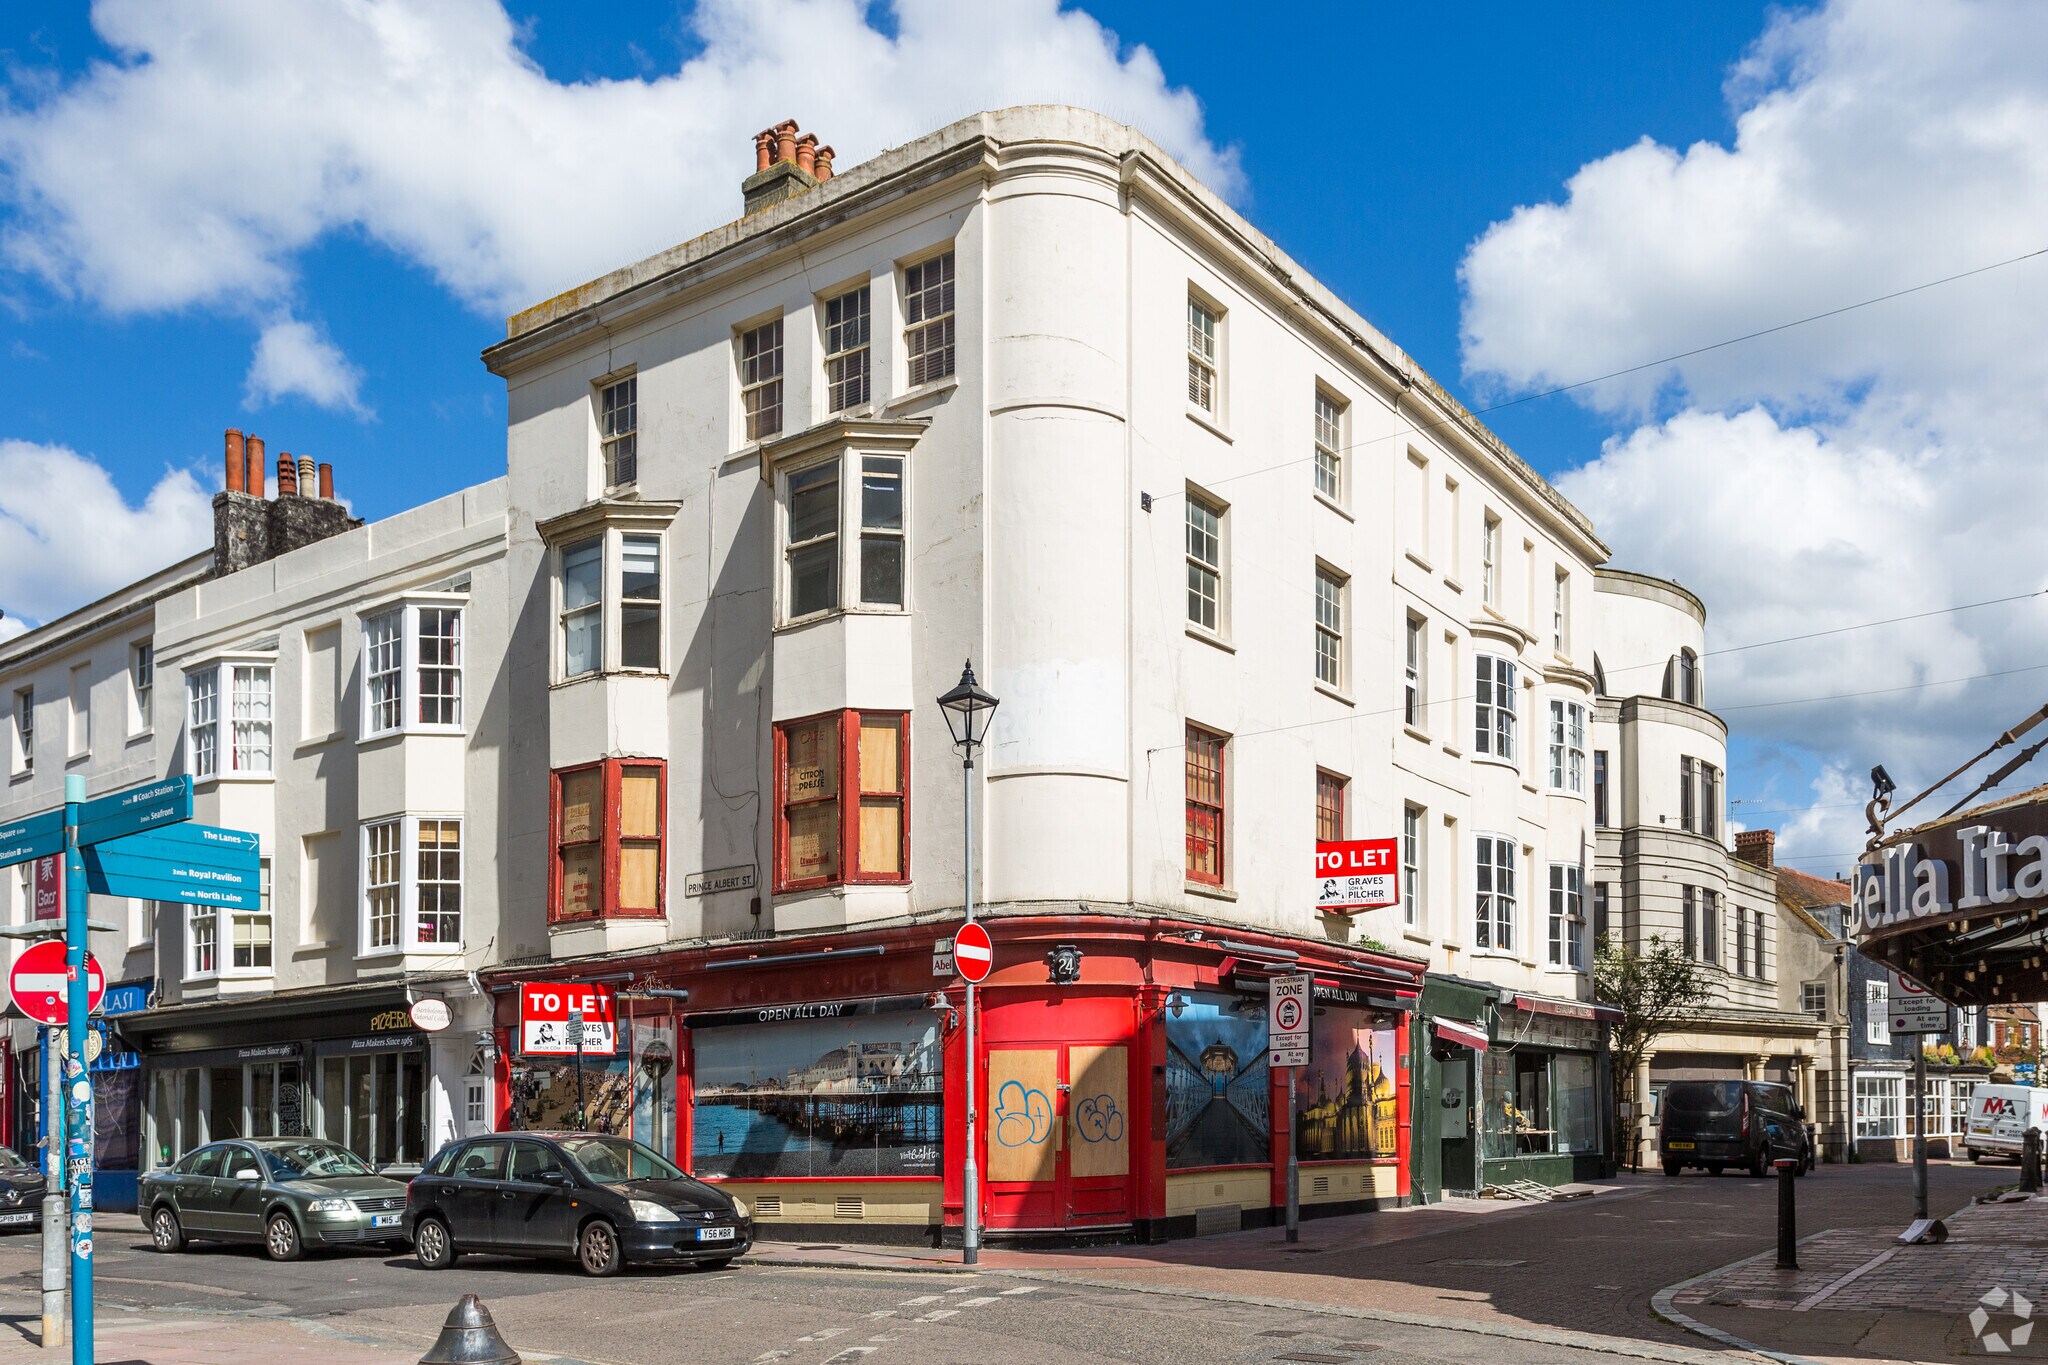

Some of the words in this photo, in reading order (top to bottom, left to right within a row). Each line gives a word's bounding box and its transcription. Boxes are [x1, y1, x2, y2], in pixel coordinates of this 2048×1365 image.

[800, 769, 825, 780] CITRON
[138, 790, 154, 801] Coach
[154, 785, 174, 797] Station
[151, 807, 174, 820] Seafront
[0, 830, 16, 840] Square
[203, 831, 218, 840] The
[219, 834, 241, 844] Lanes
[0, 849, 17, 860] Station
[1316, 851, 1343, 870] TO
[1350, 848, 1390, 868] LET
[41, 857, 54, 882] 家
[189, 869, 211, 880] Royal
[212, 872, 242, 883] Pavilion
[688, 881, 712, 893] PRINCE
[714, 877, 739, 889] ALBERT
[742, 875, 752, 885] ST.
[1348, 876, 1384, 886] GRAVES
[1348, 890, 1385, 899] PILCHER
[1851, 843, 1953, 936] Bella
[197, 891, 220, 900] North
[221, 893, 243, 903] Laine
[934, 959, 952, 971] Abel
[1058, 957, 1074, 975] 24
[1274, 977, 1305, 985] PEDESTRIAN
[1276, 984, 1303, 997] ZONE
[1332, 990, 1344, 1001] ALL
[1345, 991, 1358, 1002] DAY
[529, 993, 560, 1012] TO
[568, 994, 610, 1013] LET
[413, 1014, 433, 1022] Tutorial
[759, 1007, 791, 1022] OPEN
[794, 1006, 815, 1019] ALL
[820, 1004, 843, 1017] DAY
[370, 1010, 413, 1031] PIZZERIA
[351, 1040, 365, 1048] Pizza
[365, 1038, 385, 1047] Makers
[386, 1037, 400, 1046] Since
[400, 1035, 414, 1047] 1965
[1276, 1034, 1293, 1042] Except
[238, 1049, 250, 1058] Pizza
[251, 1048, 267, 1057] Makers
[267, 1046, 279, 1055] Since
[704, 1229, 717, 1239] Y56
